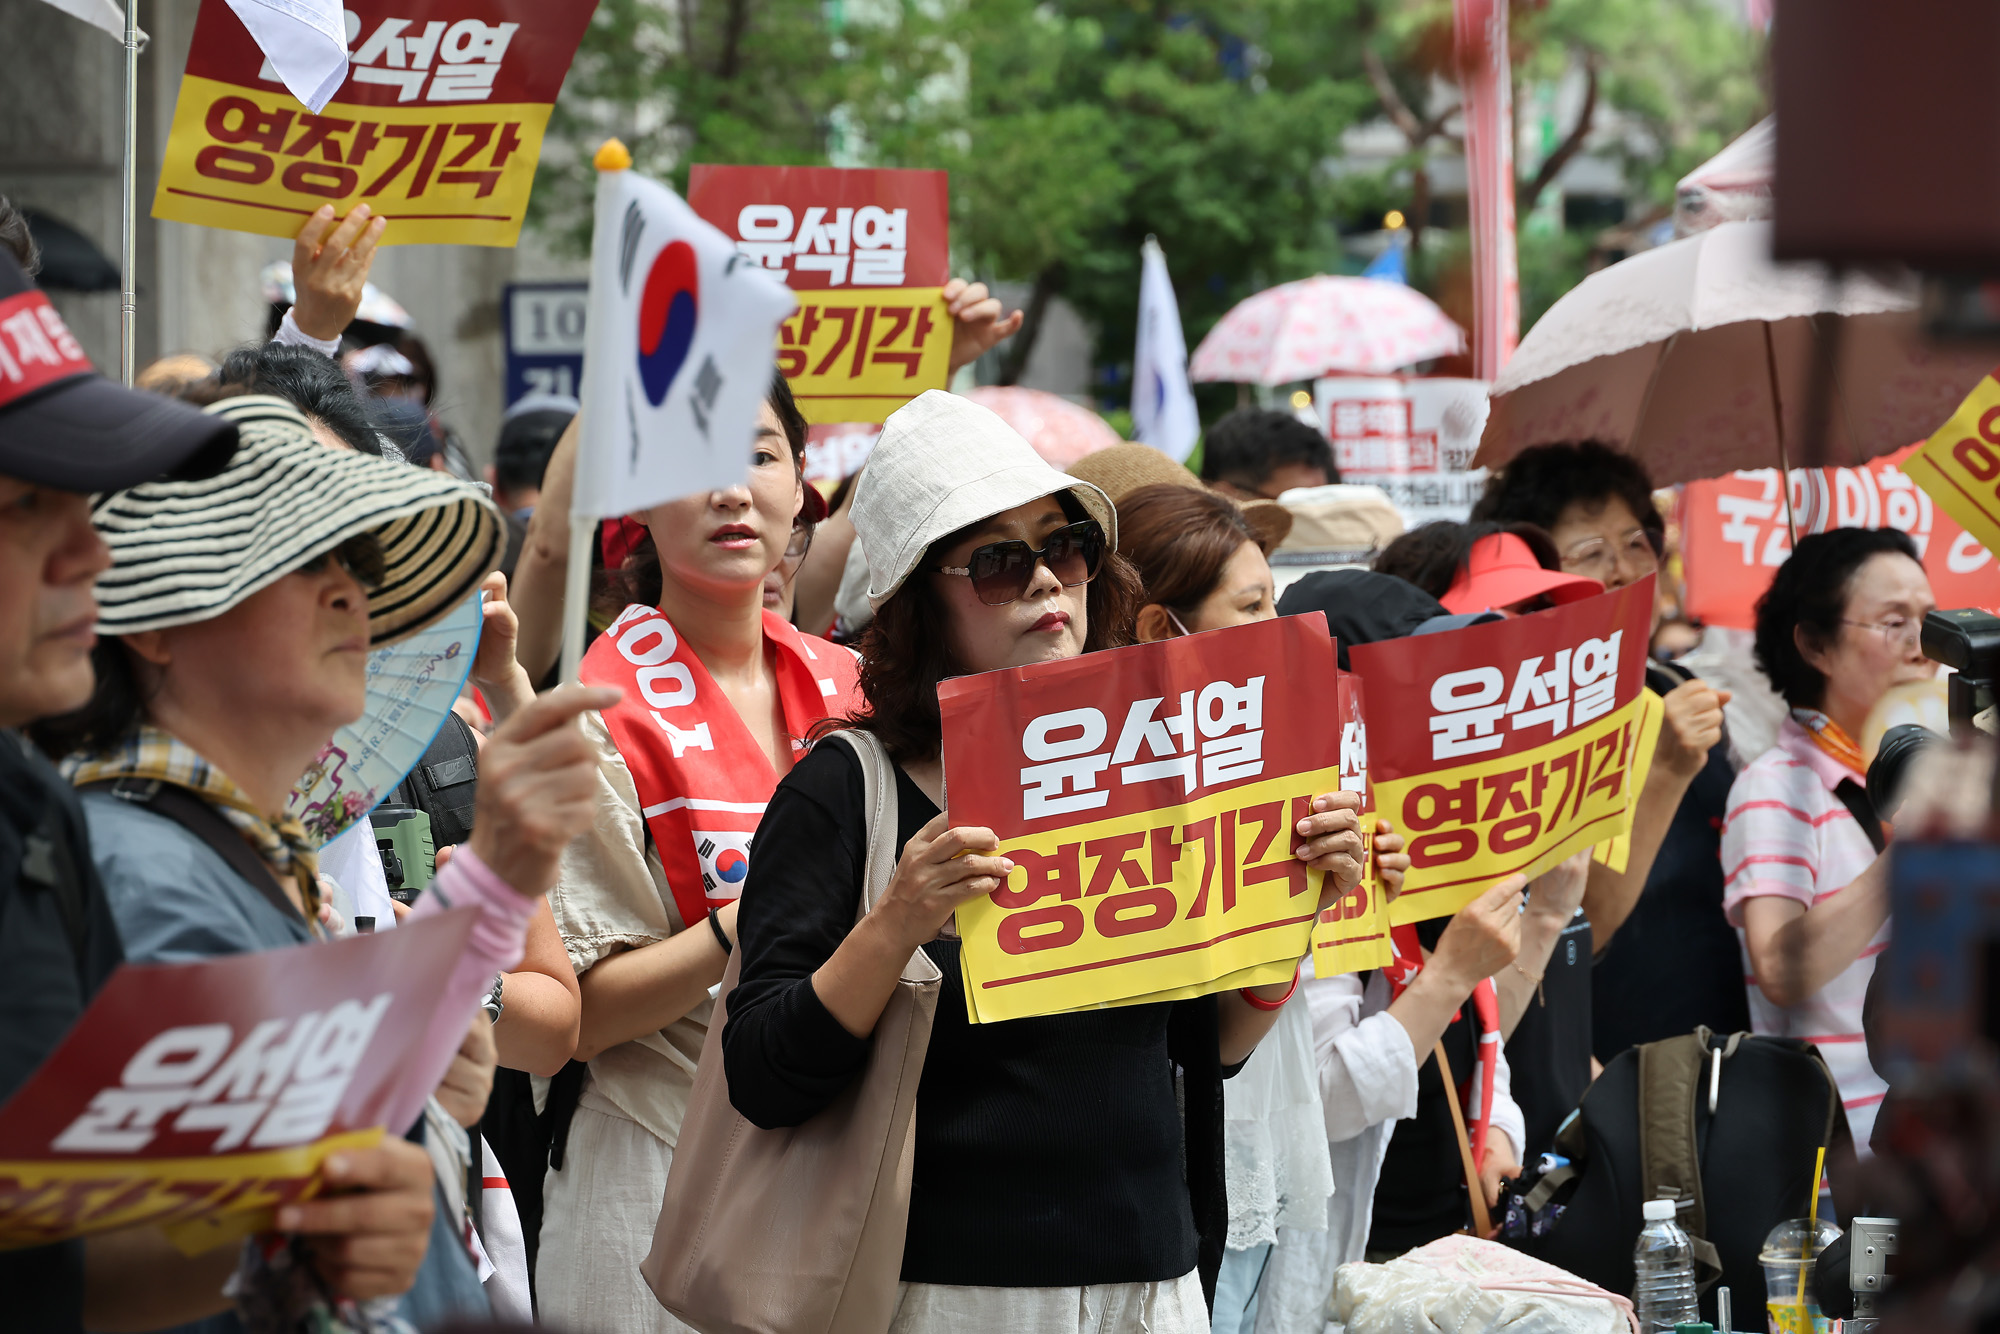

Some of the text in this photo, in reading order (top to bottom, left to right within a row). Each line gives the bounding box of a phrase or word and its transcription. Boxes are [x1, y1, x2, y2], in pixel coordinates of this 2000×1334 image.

[258, 9, 521, 103] 석열
[194, 95, 522, 199] 영장기각
[735, 204, 908, 287] 윤석열
[776, 305, 934, 379] 장기각
[1020, 676, 1266, 821] 윤석열
[1429, 629, 1623, 761] 윤석열
[1402, 719, 1633, 869] 영장기각
[988, 794, 1313, 956] 영장기각
[51, 993, 393, 1152] 윤석열
